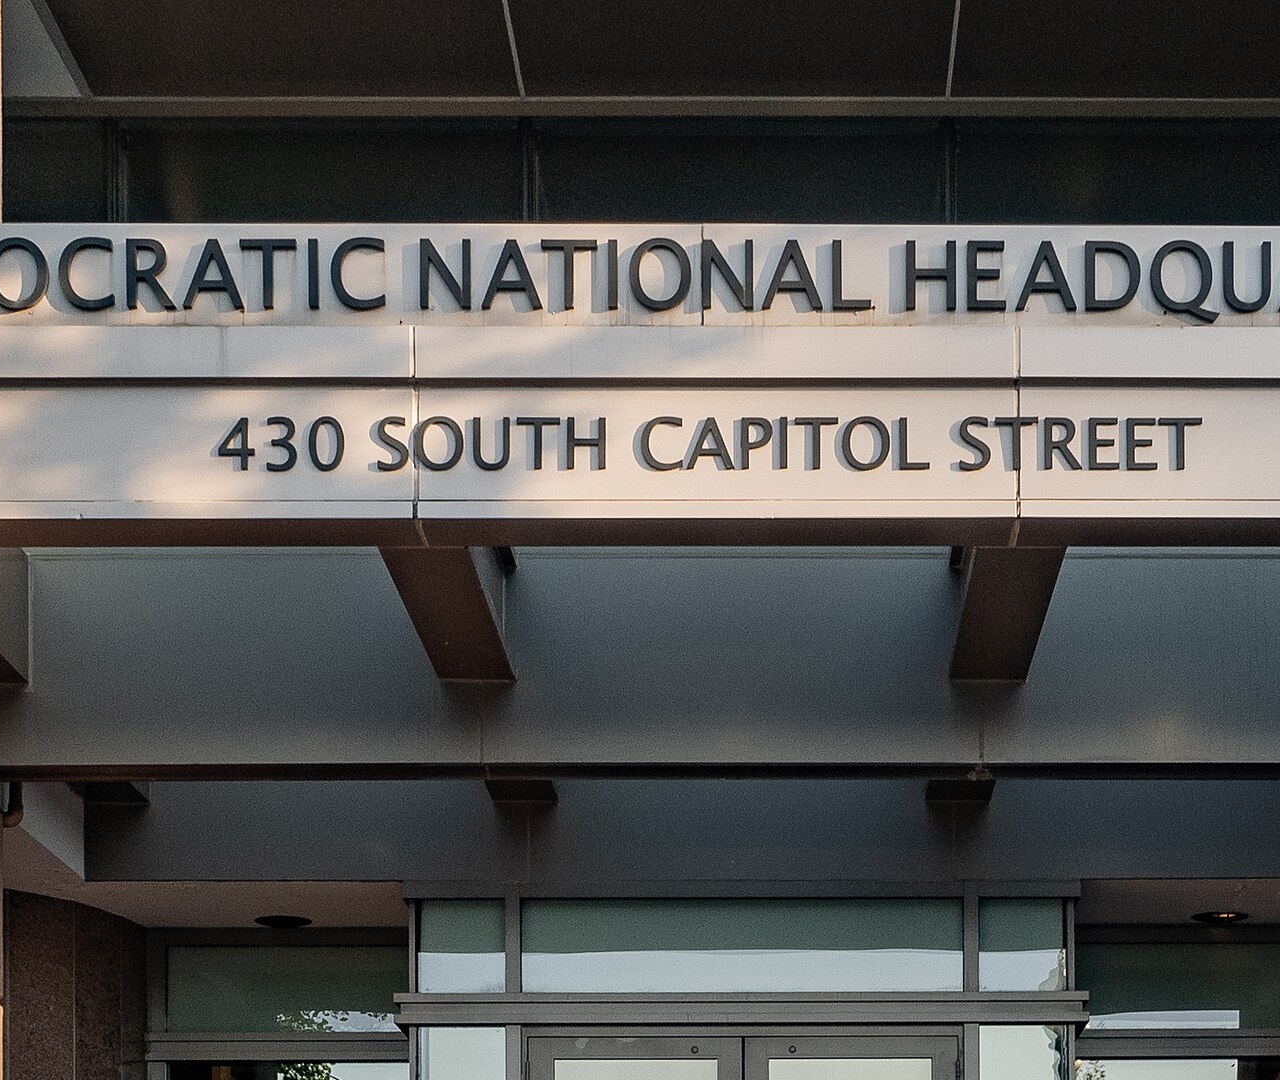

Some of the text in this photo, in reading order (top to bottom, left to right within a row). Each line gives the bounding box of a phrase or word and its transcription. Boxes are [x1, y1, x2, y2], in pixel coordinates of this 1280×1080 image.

[419, 237, 873, 312] NATIONAL
[217, 416, 1203, 473] 430 SOUTH CAPITOL STREET
